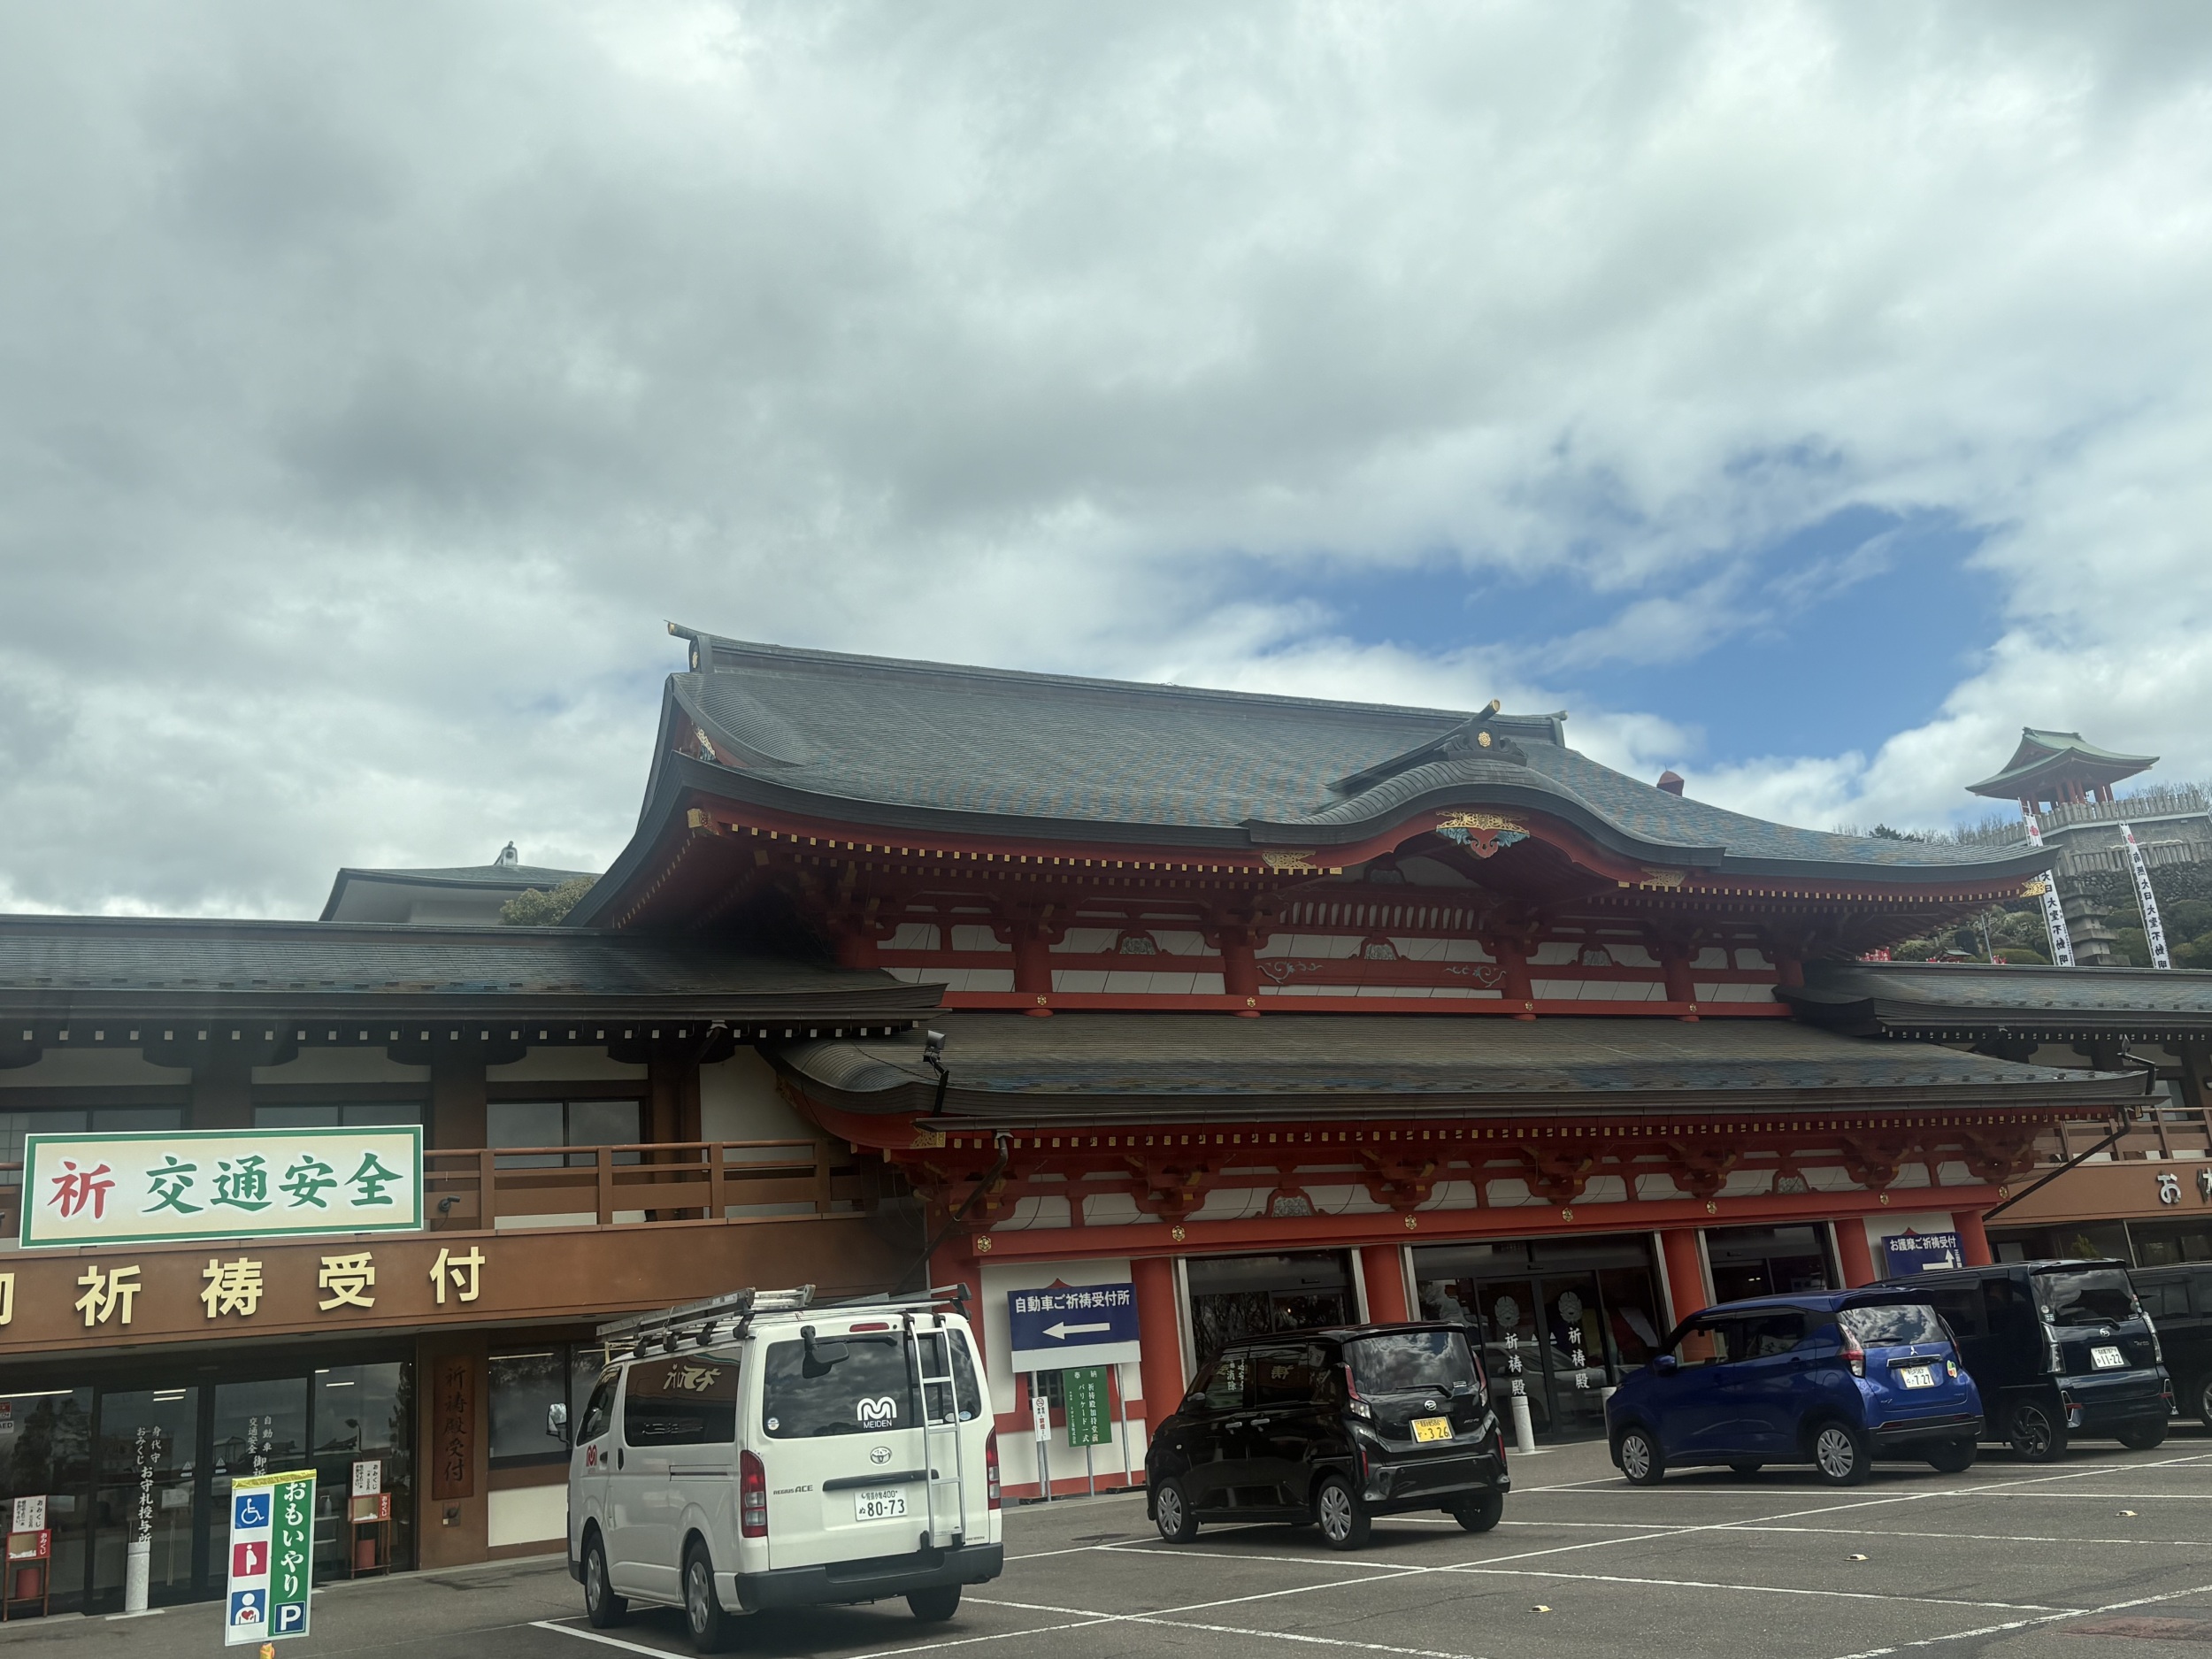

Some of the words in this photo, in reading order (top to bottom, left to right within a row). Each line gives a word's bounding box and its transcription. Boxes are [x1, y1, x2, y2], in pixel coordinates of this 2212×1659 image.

[48, 1161, 115, 1220] 祈
[142, 1153, 403, 1214] 交通安全
[1890, 1235, 1956, 1251] お護摩ご祈祷受付
[0, 1246, 486, 1327] 祈祷受付
[1015, 1290, 1130, 1313] 自動車ご祈祷受付所
[1504, 1332, 1526, 1395] 祈祷殿
[1568, 1326, 1590, 1389] 祈祷殿
[443, 1365, 467, 1481] 祈祷殿受付
[864, 1419, 893, 1429] MEIDEN
[1079, 1384, 1089, 1442] バリケード一式
[135, 1427, 146, 1465] おみくじ
[150, 1425, 162, 1463] 身代守
[248, 1417, 258, 1454] 交通安全
[262, 1416, 273, 1452] 自動車
[138, 1466, 154, 1543] お守札授与所
[867, 1499, 905, 1517] 80-73
[883, 1490, 895, 1499] 400
[280, 1481, 307, 1599] おもいやり
